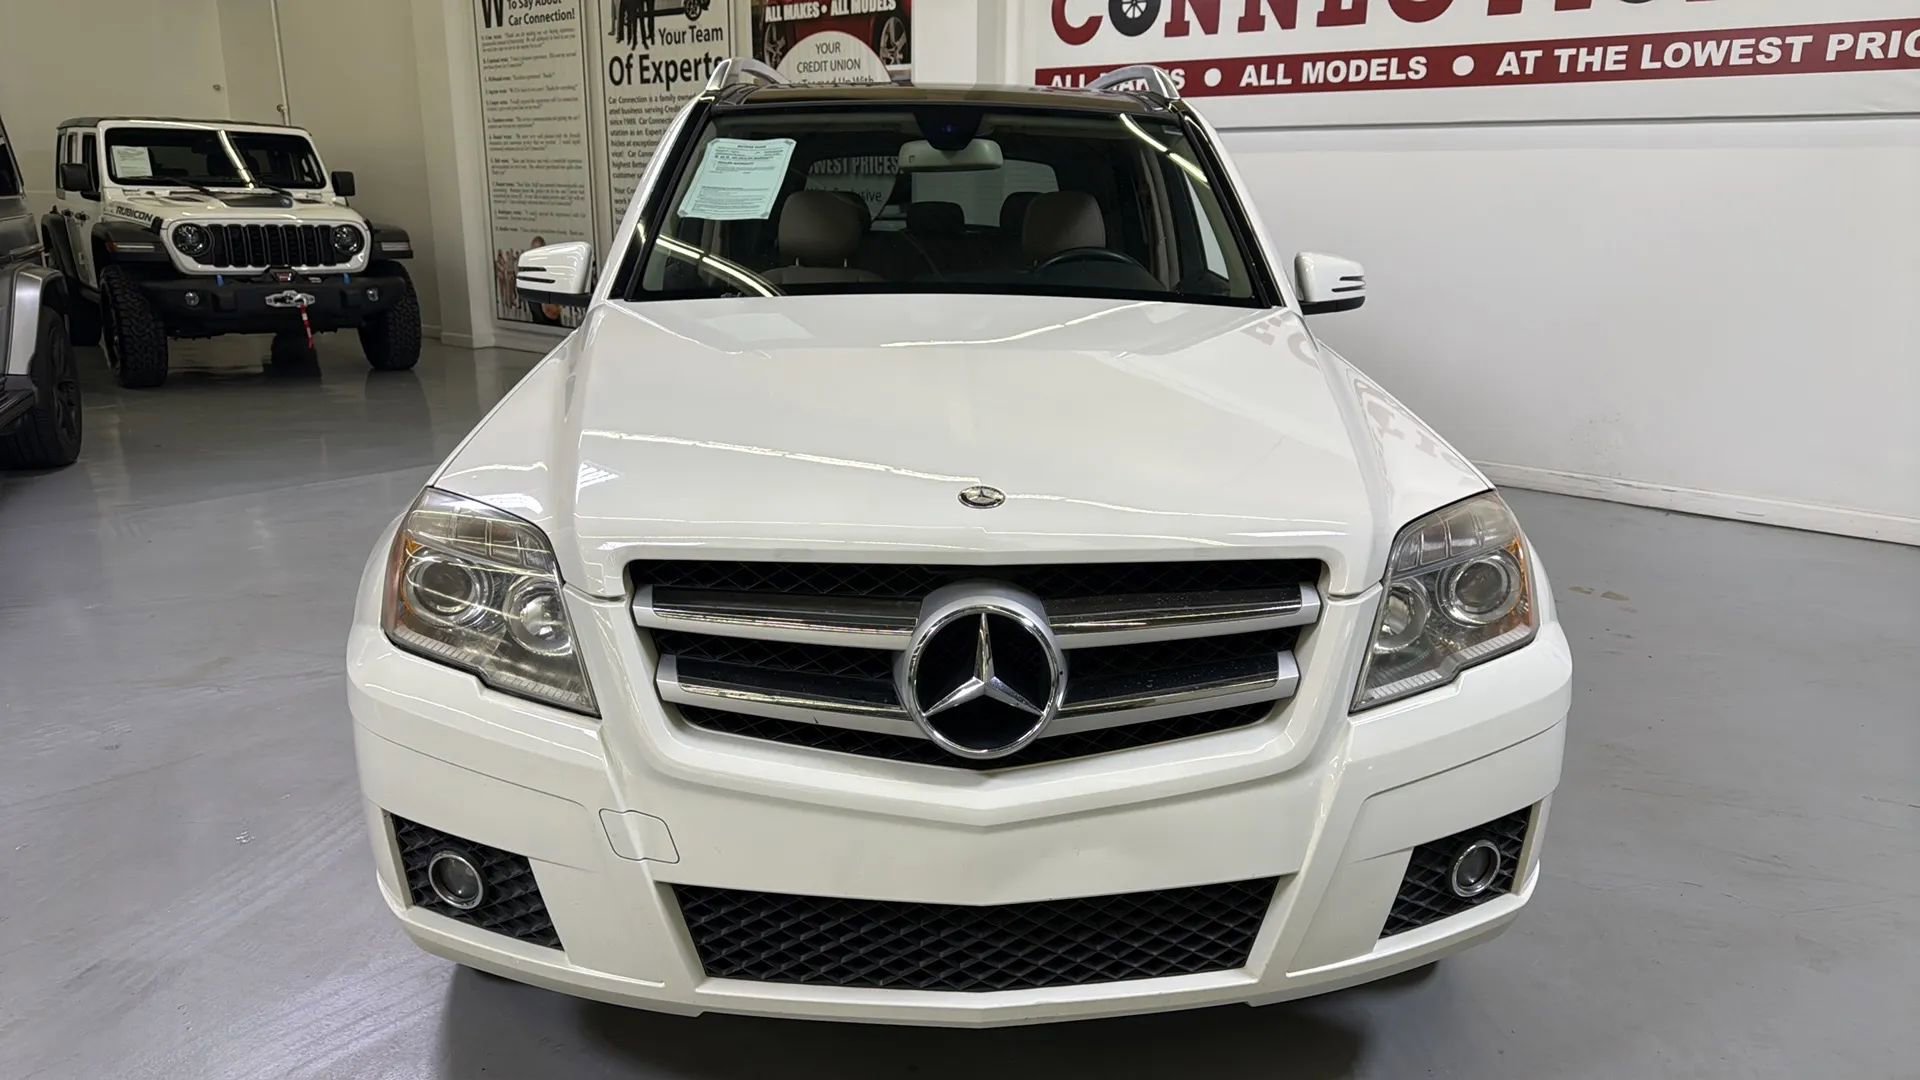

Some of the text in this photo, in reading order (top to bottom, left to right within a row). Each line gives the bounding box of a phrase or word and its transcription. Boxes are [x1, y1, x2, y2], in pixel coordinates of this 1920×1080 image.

[507, 0, 517, 10] To
[519, 0, 533, 10] Say
[765, 0, 897, 23] ALL MAKES ALL MODELS
[508, 8, 575, 26] Car Connection!
[658, 25, 723, 46] Your Team
[815, 42, 841, 54] YOUR
[797, 59, 861, 73] CREDIT UNION
[1240, 64, 1293, 87] ALL
[1301, 55, 1428, 85] MODELS
[1495, 50, 1543, 76] AT
[1553, 44, 1629, 73] THE
[1640, 35, 1813, 70] LOWEST
[609, 53, 634, 86] Of
[639, 52, 723, 91] Expert
[116, 206, 153, 222] RUBICON
